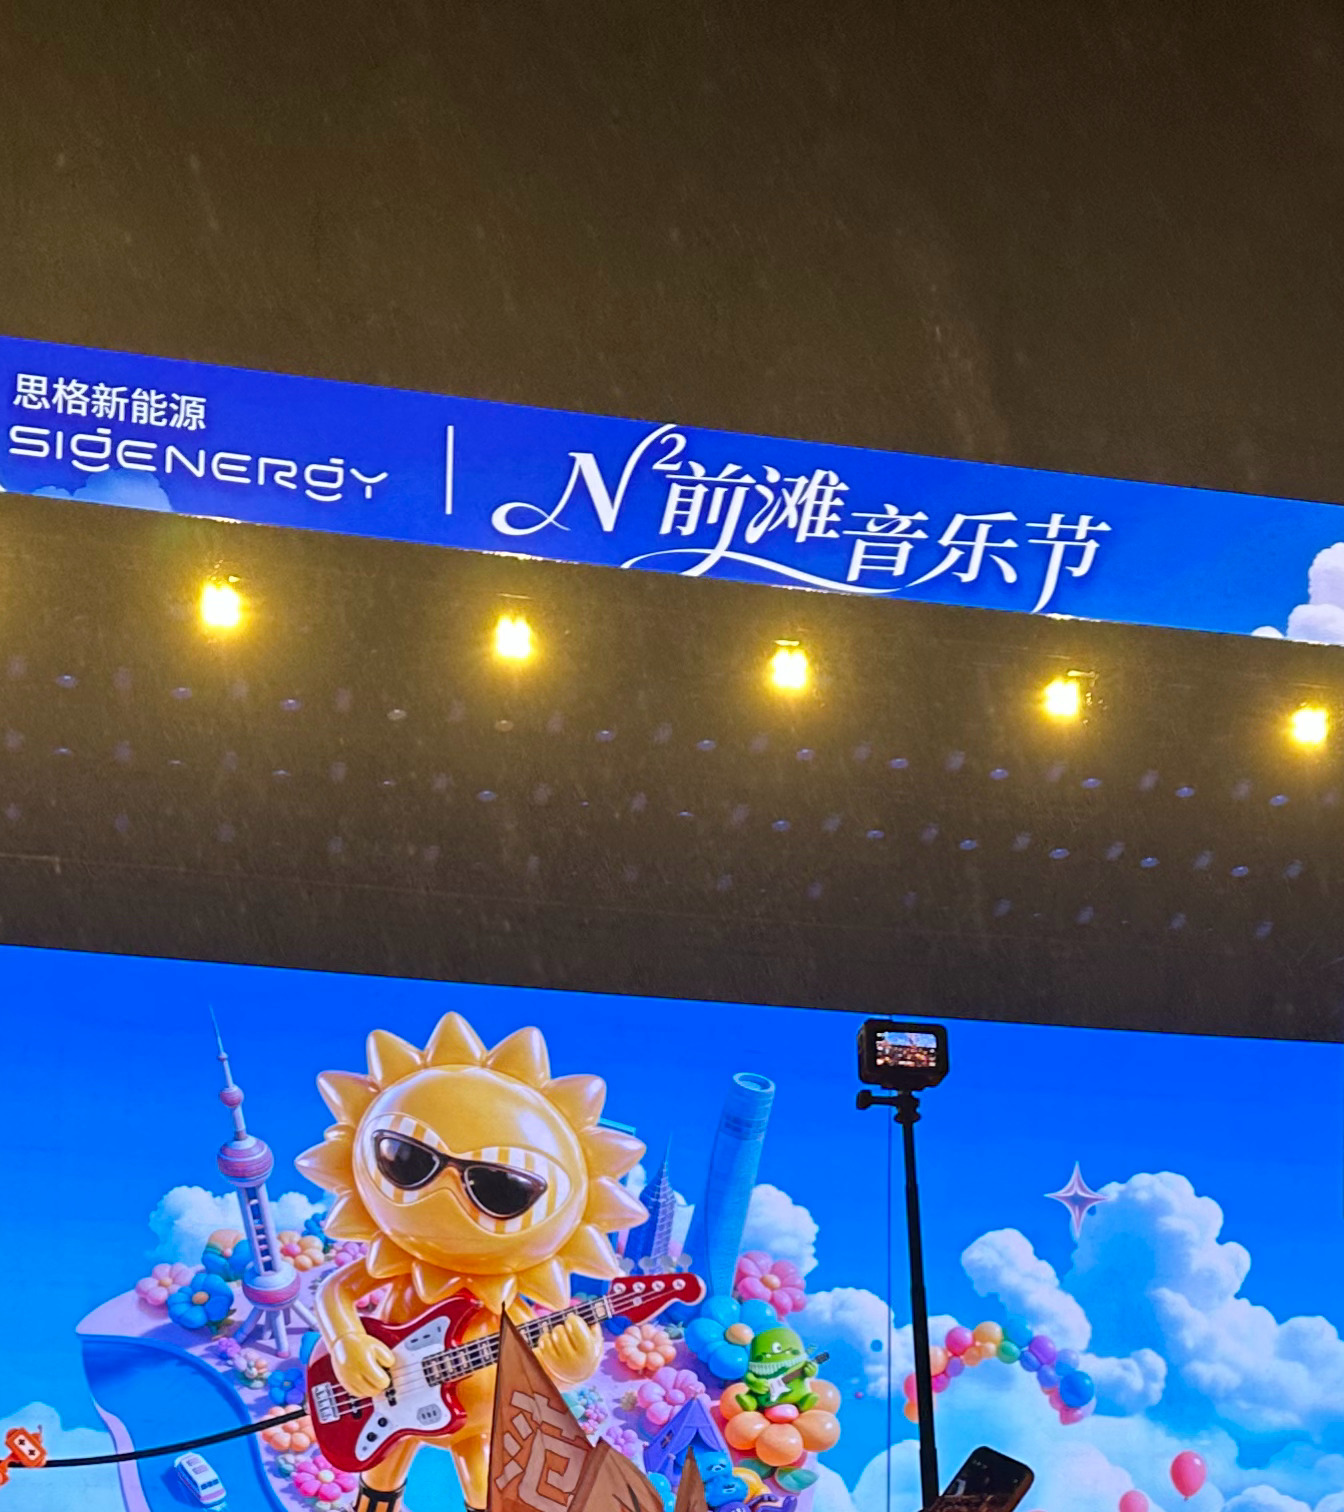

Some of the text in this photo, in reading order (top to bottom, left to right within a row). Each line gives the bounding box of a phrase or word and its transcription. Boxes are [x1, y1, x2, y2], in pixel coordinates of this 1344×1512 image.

[13, 373, 207, 431] 思格新能源
